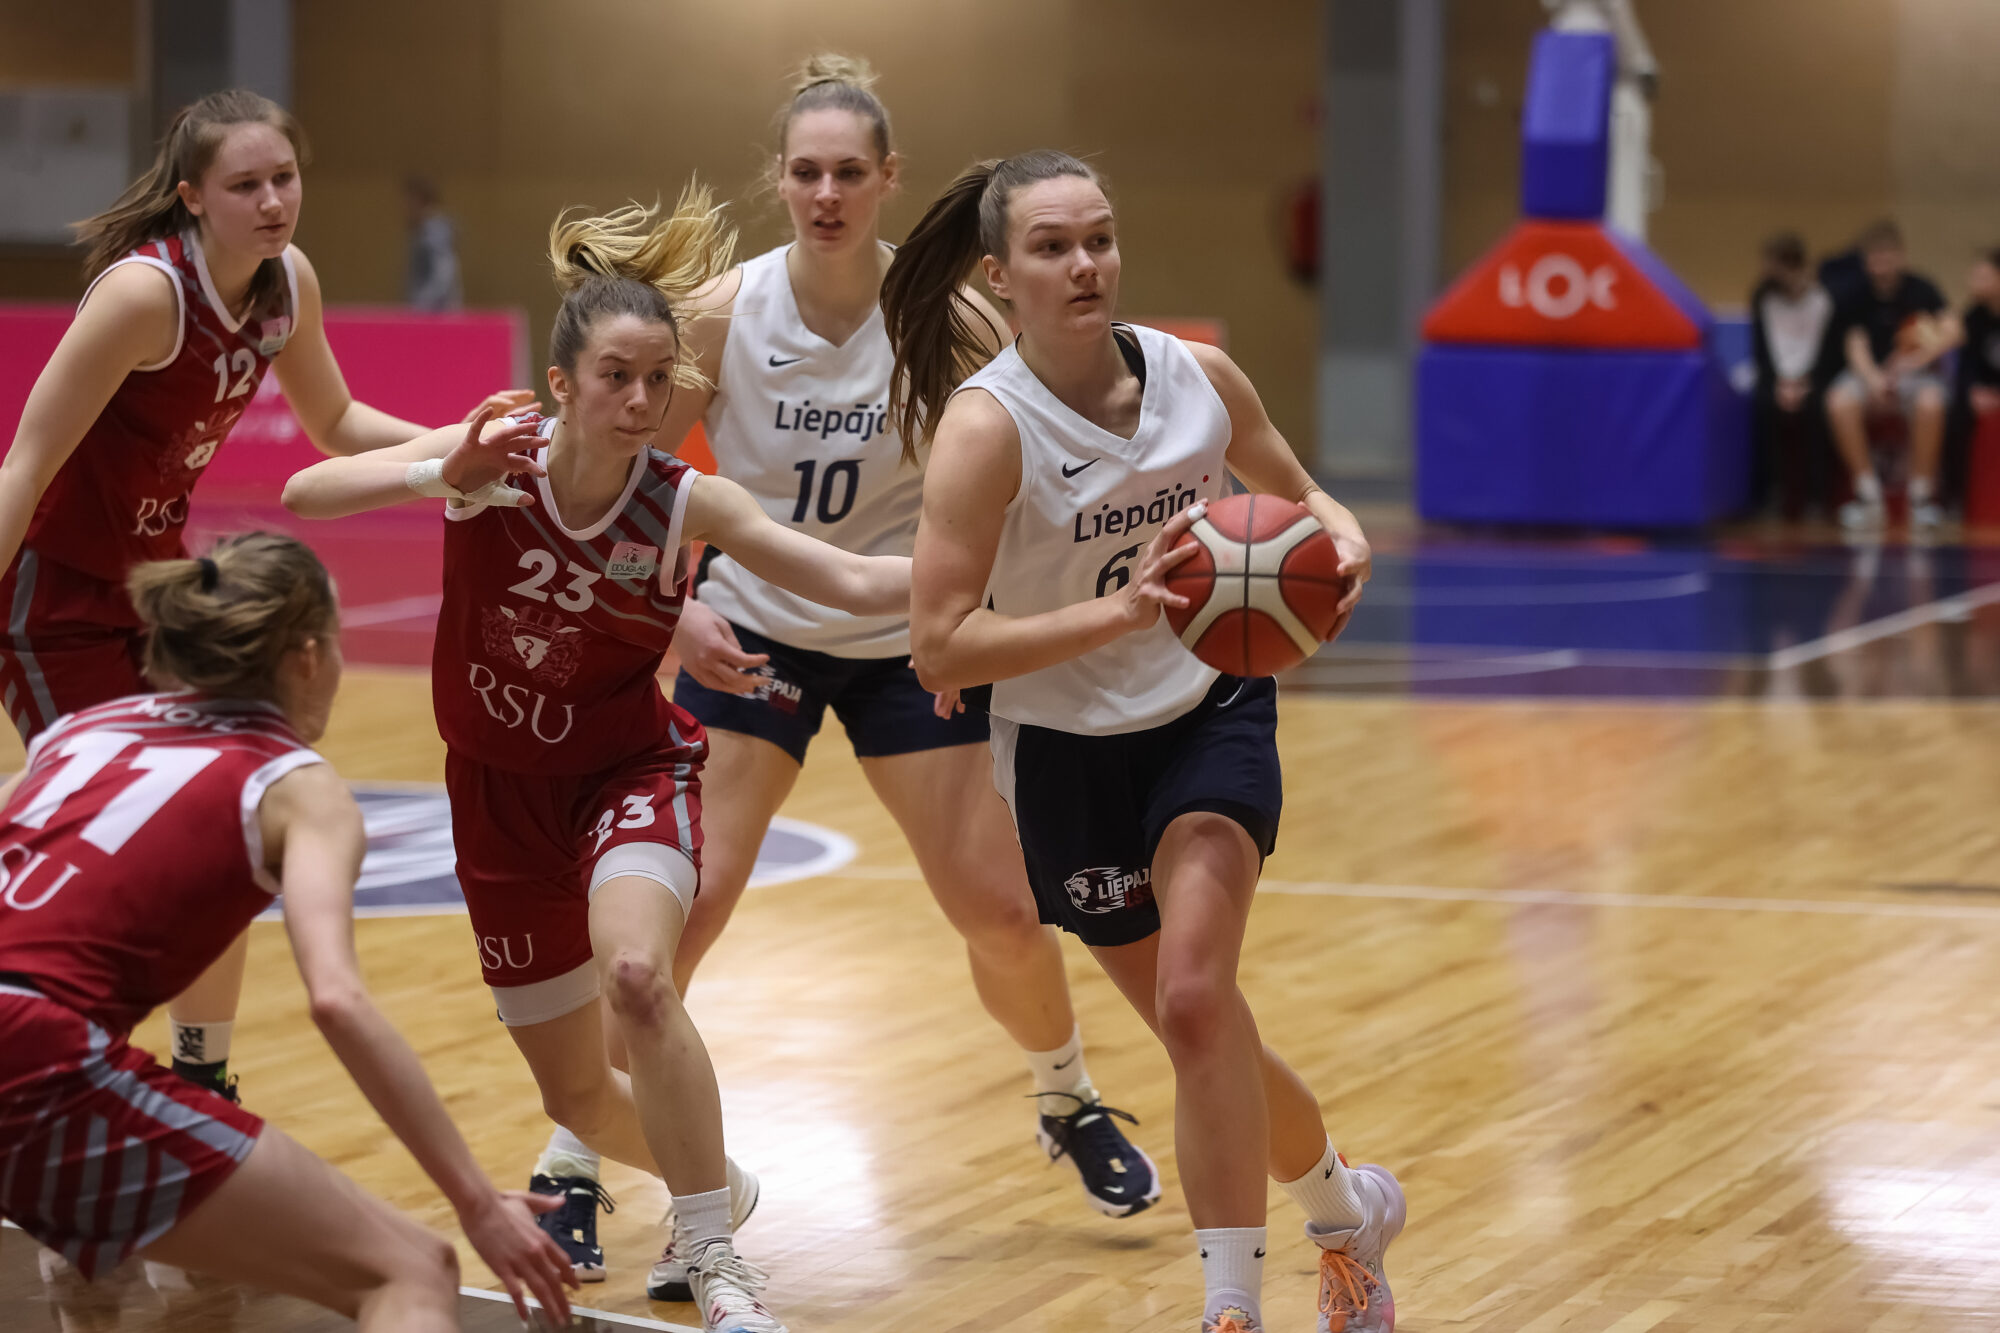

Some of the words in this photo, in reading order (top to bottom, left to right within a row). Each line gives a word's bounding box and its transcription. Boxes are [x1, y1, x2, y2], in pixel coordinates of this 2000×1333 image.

[213, 347, 256, 404] 12
[791, 459, 866, 525] 10
[507, 548, 602, 613] 23
[1095, 541, 1149, 599] 6
[467, 661, 576, 744] RSU
[10, 730, 223, 856] 11
[587, 793, 656, 857] 23
[0, 842, 82, 911] SU
[1097, 867, 1150, 900] LIEPAJ
